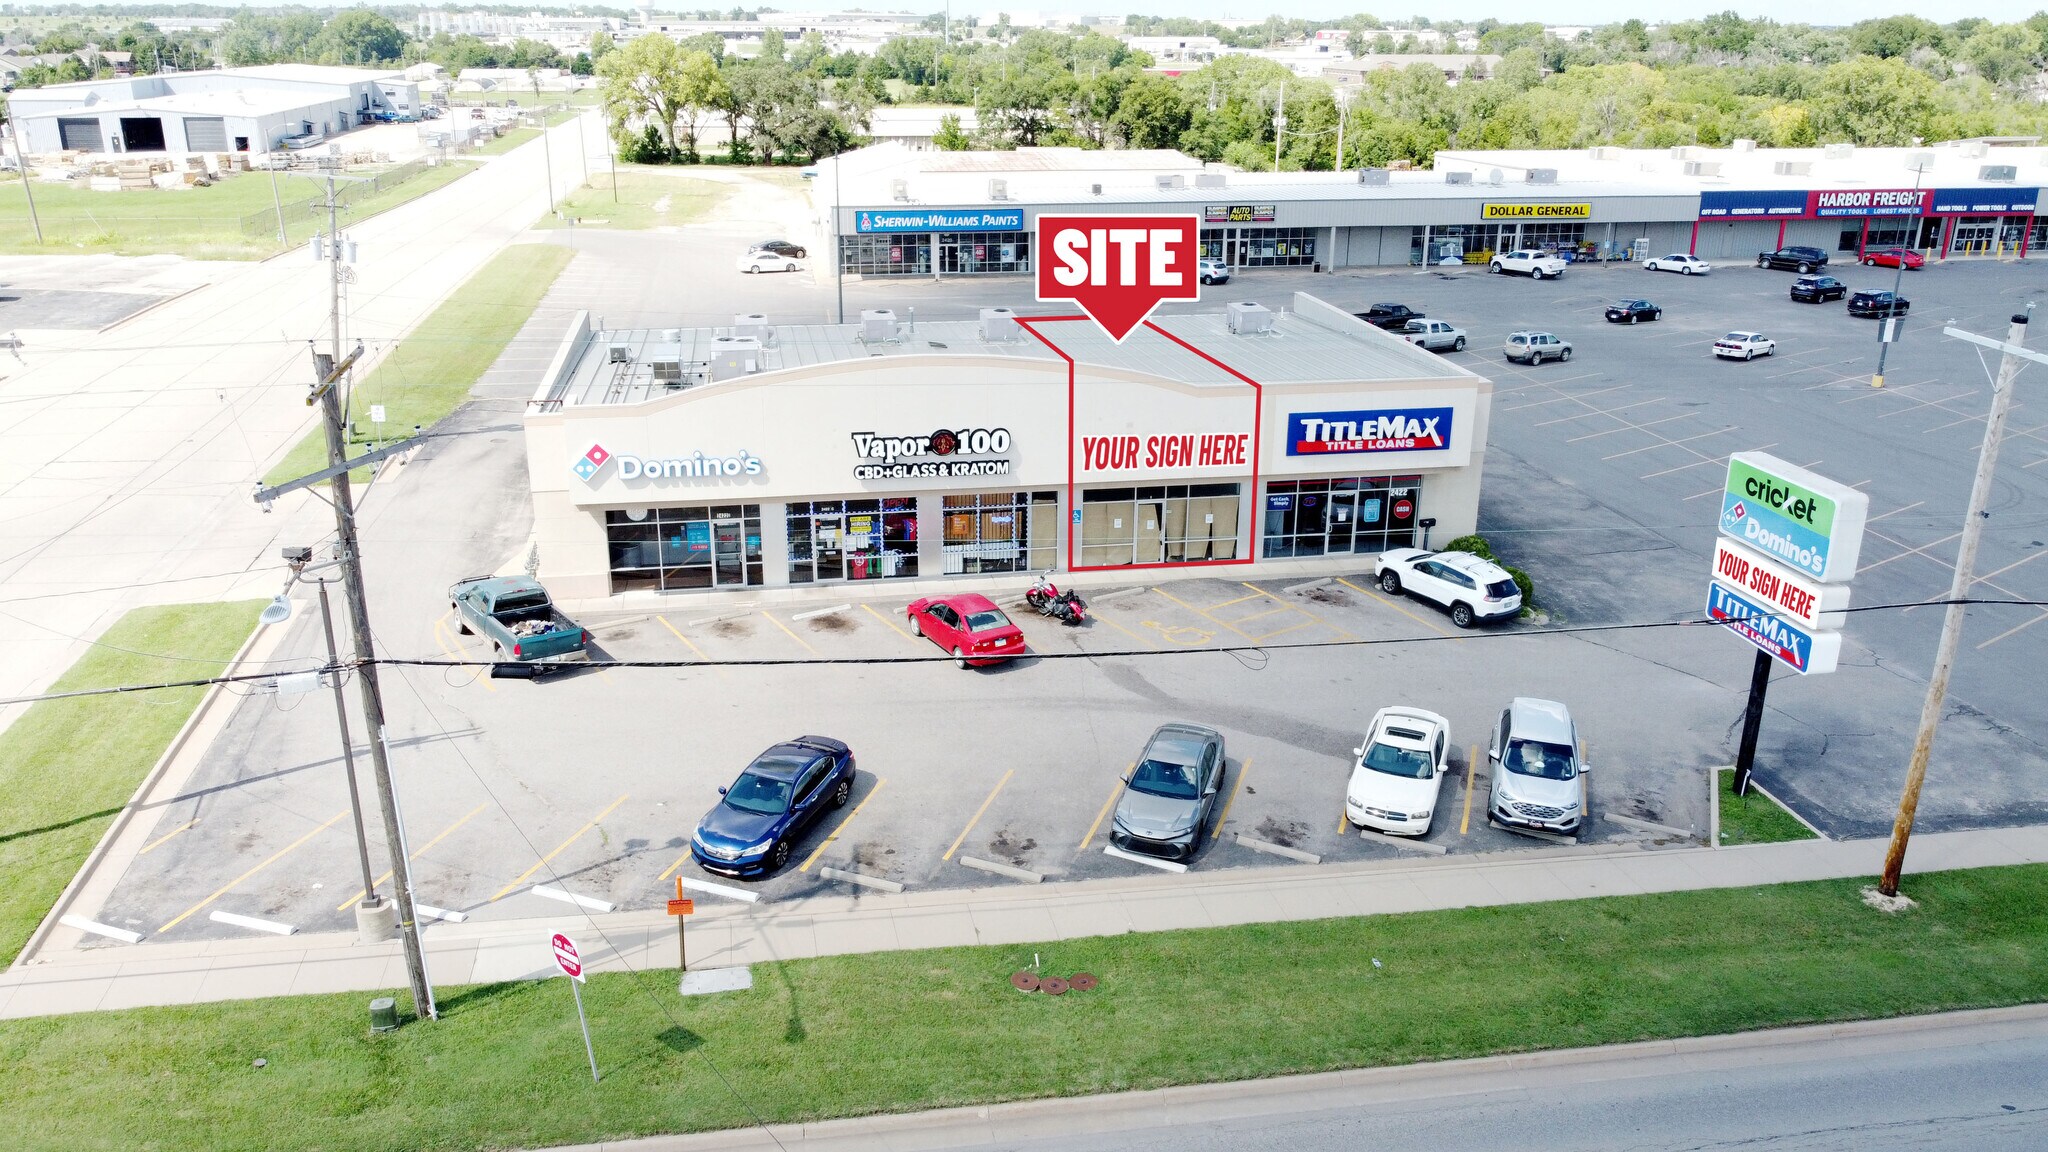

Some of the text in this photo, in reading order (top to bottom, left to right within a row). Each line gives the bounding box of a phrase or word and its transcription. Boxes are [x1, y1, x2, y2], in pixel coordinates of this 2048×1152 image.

[1818, 191, 1926, 207] HARBOR FREIGHT
[1229, 213, 1251, 221] PARTS
[1490, 206, 1585, 216] DOLLAR GENERAL
[1701, 208, 1712, 216] OFF
[874, 214, 1018, 228] SHERWIN-WILLIAMS PAINTS
[851, 428, 1011, 464] Vapor 100
[1326, 439, 1415, 451] TITLE LOANS
[617, 449, 762, 480] Domino's
[854, 460, 1010, 480] CBD+GLASS & KRATOM
[1390, 488, 1408, 497] 2422
[1744, 476, 1817, 525] cricket
[1744, 516, 1823, 574] Domino's
[1750, 632, 1782, 655] LOANS
[553, 937, 575, 954] DO NOT
[560, 957, 578, 972] ENTER
